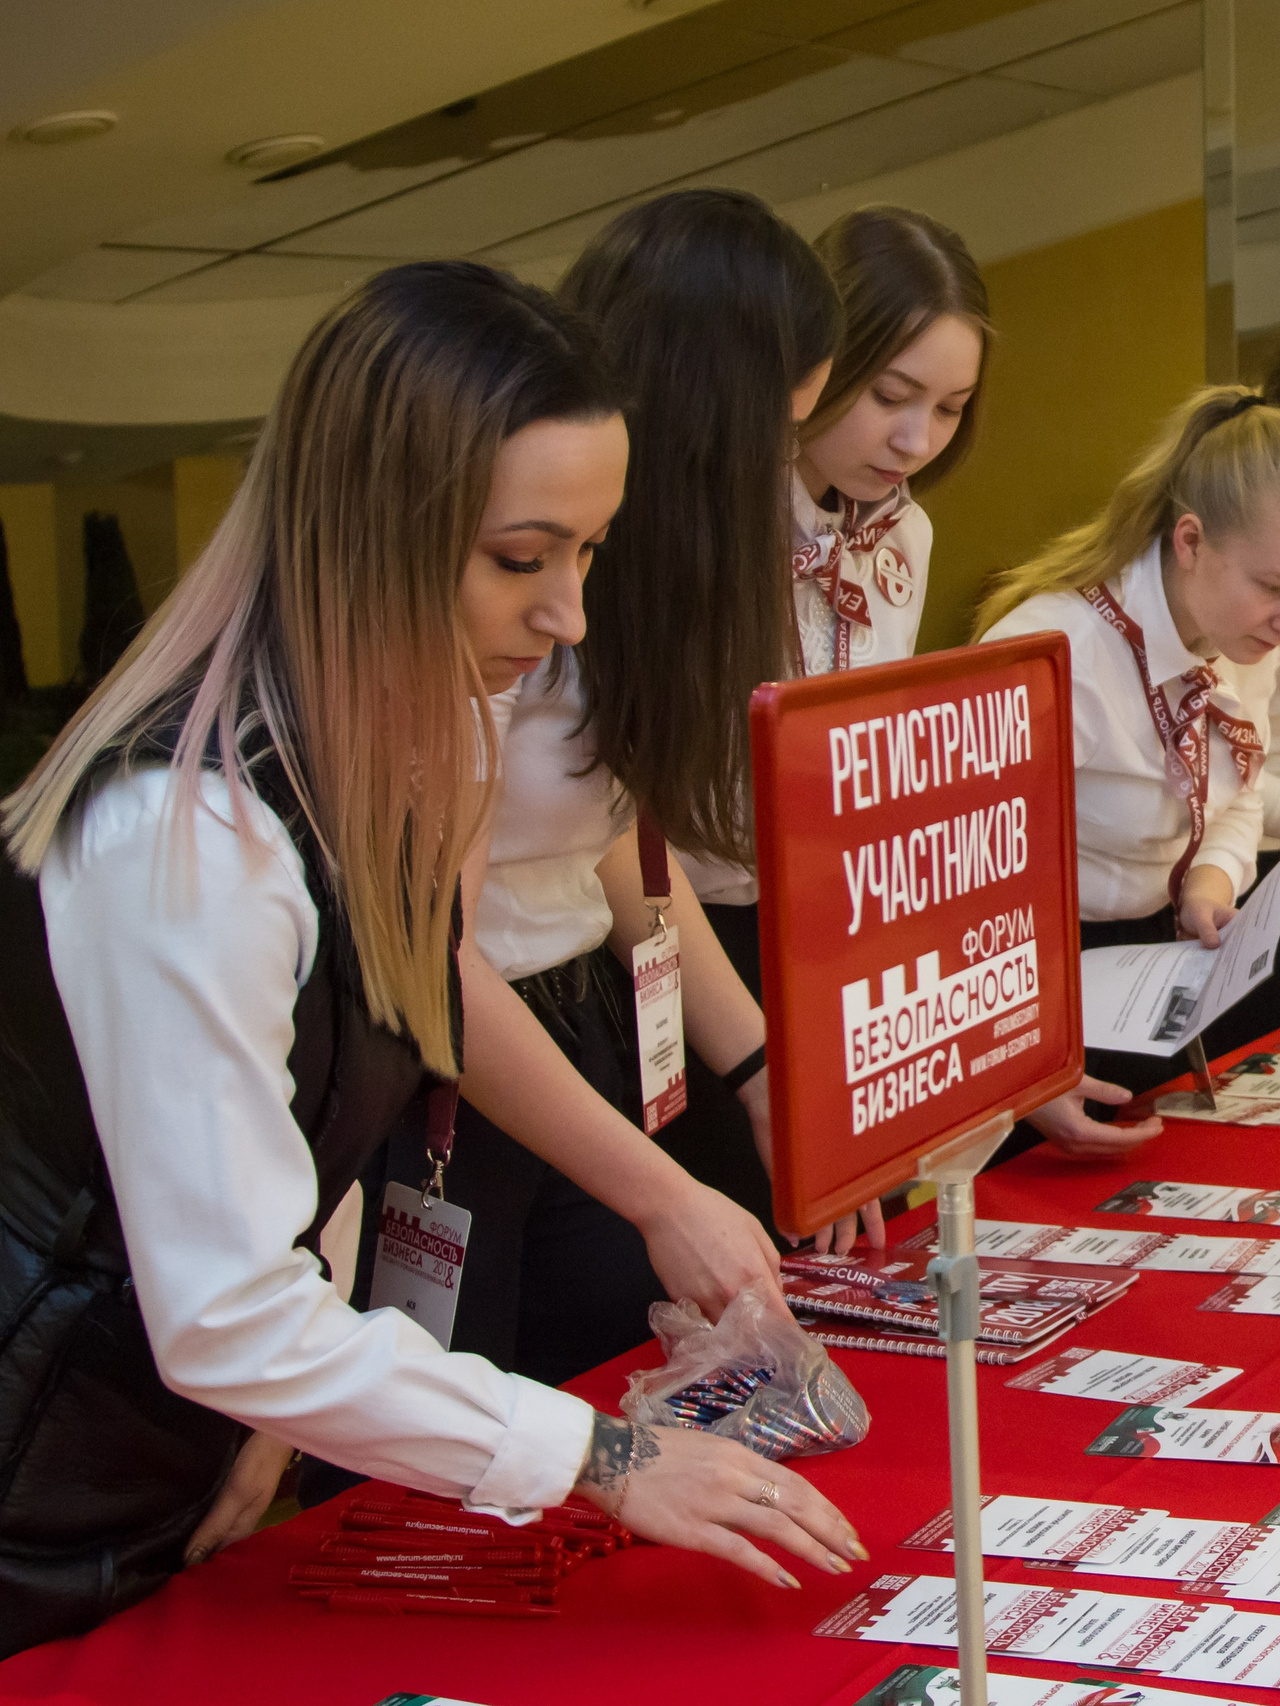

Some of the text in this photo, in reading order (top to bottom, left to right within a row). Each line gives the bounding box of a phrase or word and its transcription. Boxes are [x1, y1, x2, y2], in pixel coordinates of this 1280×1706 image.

[829, 685, 1031, 816] РЕГИСТРАЦИЯ
[843, 796, 1028, 935] УЧАСТНИКОВ
[961, 904, 1035, 965] ФОРУМ
[852, 953, 1035, 1067] БЕЗОПАСНОСТЬ
[852, 1042, 964, 1136] БИЗНЕСА
[385, 1221, 458, 1262] БЕЗОПАСНОСТЬ
[430, 1221, 462, 1244] ФОРУМ
[383, 1239, 423, 1268] БИЗНЕСА
[818, 1267, 886, 1287] SECURIT
[1066, 1509, 1136, 1557] БЕЗОПАСНОСТЬ
[1074, 1508, 1118, 1535] БИЗНЕСА
[1083, 1537, 1118, 1558] ФОРУМ
[1200, 1527, 1263, 1578] БЕЗОПАСНОСТЬ
[1203, 1526, 1244, 1555] БИЗНЕСА
[376, 1552, 464, 1565] www.forum-security.ru
[1218, 1556, 1251, 1579] ФОРУМ
[989, 1591, 1064, 1647] БЕЗОПАСНОСТЬ
[999, 1589, 1046, 1621] БИЗНЕСА
[1104, 1608, 1125, 1621] ВАДИМ
[1129, 1603, 1177, 1636] БИЗНЕСА
[1008, 1623, 1046, 1648] ФОРУМ
[1074, 1621, 1110, 1647] НИКОЛАЕВИЧ
[1122, 1605, 1195, 1662] БЕЗОПАСНОСТЬ
[1214, 1624, 1267, 1669] АЛЕКСЕЙ АНАТОЛЬЕВИЧ
[1141, 1639, 1177, 1664] ФОРУМ
[1233, 1663, 1257, 1680] БИЗНЕСА
